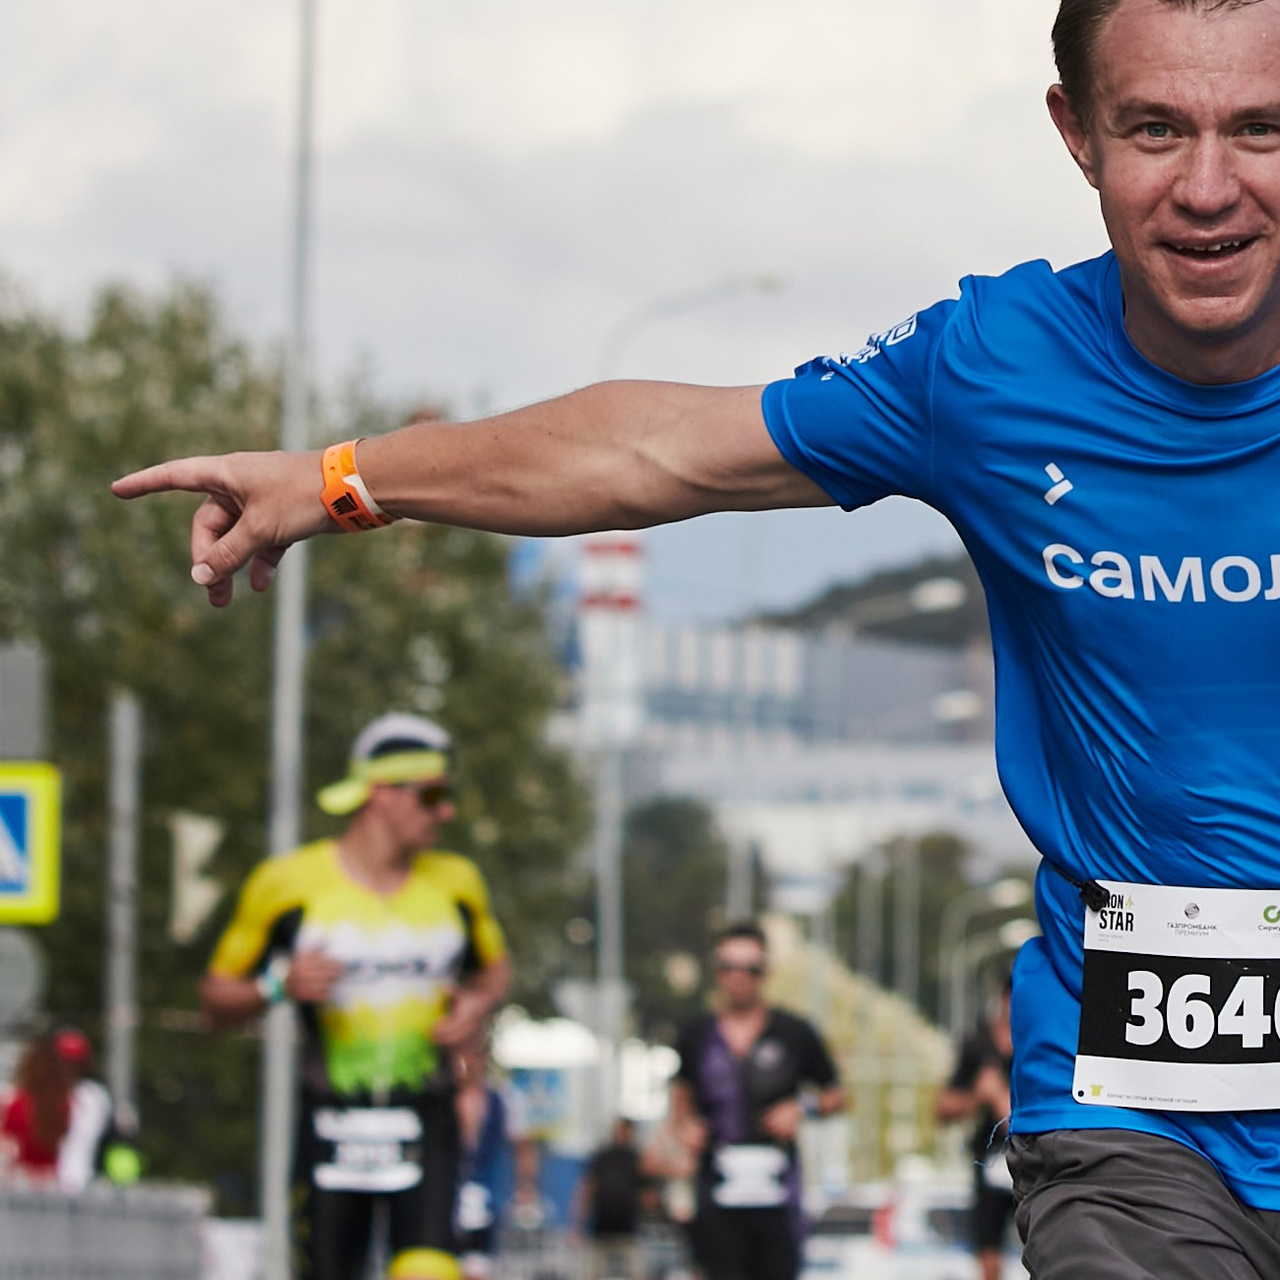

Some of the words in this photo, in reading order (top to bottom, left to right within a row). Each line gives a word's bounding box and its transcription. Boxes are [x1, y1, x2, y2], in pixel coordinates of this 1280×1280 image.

[1102, 893, 1124, 910] RON
[1099, 909, 1134, 932] STAR
[1166, 921, 1218, 931] ГАЗПРОМБАНК
